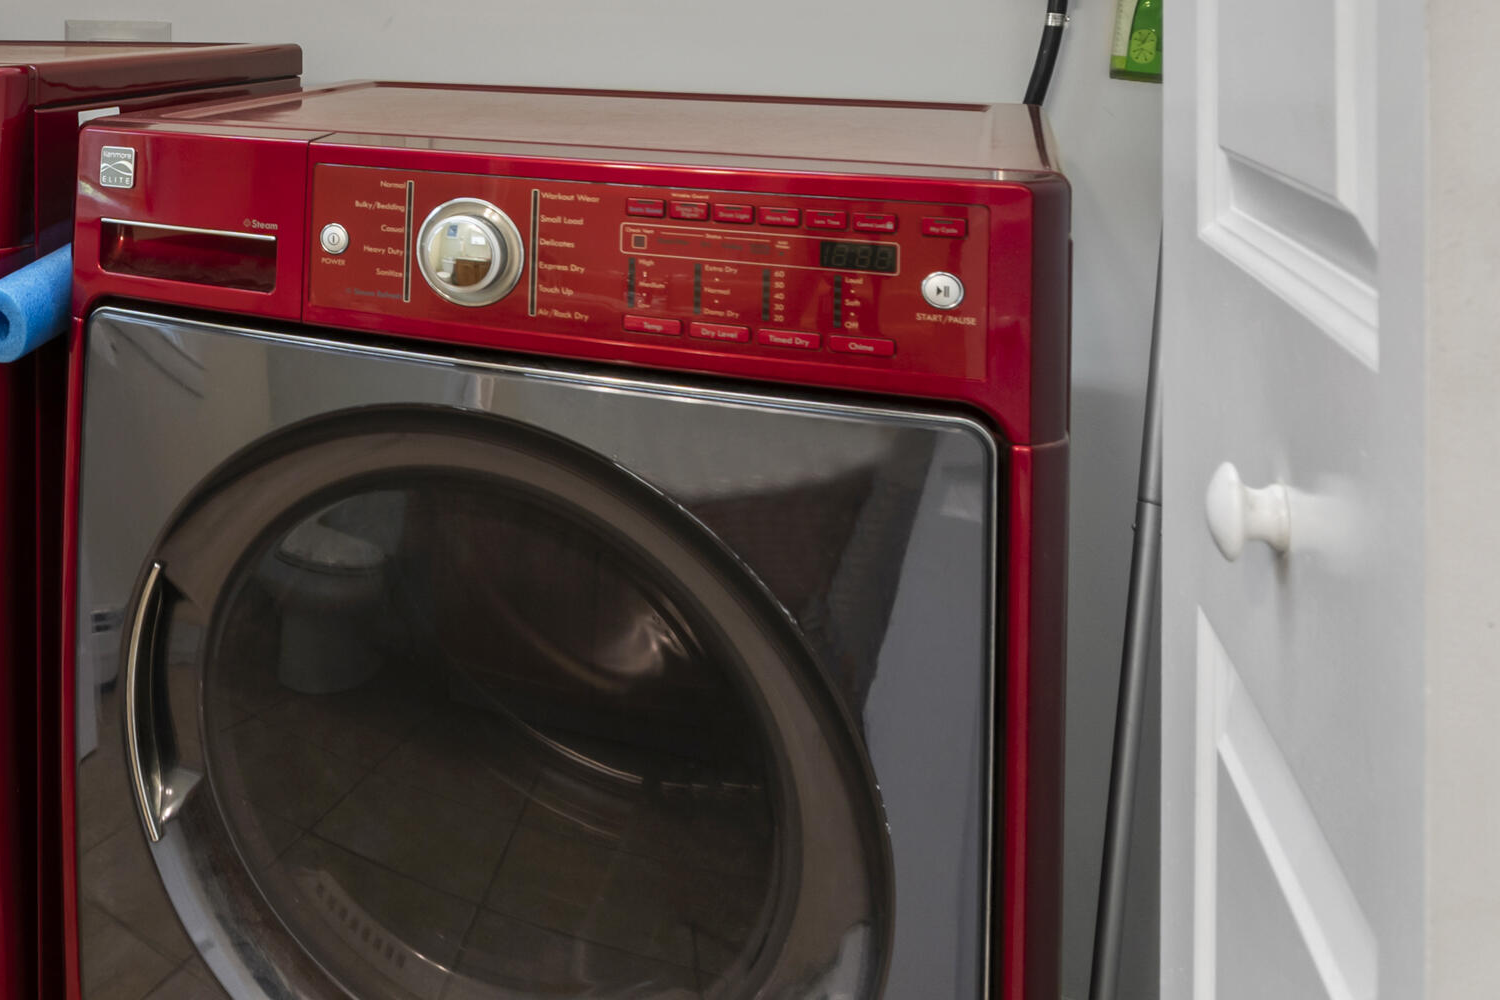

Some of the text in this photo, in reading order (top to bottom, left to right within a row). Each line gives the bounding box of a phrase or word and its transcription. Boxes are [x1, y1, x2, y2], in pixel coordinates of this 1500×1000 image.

[103, 149, 132, 160] Kenmore
[102, 175, 131, 185] ELITE
[380, 180, 406, 189] Normal
[541, 191, 600, 203] Workout Wear
[355, 200, 405, 213] Bulky/Bedding
[540, 214, 584, 225] Small Load
[252, 219, 278, 231] Steam
[381, 224, 405, 233] Casual
[540, 238, 575, 248] Delicates
[363, 245, 404, 256] Heavy Duty
[321, 257, 346, 266] POWER
[638, 258, 654, 267] High
[539, 261, 585, 274] Express Dry
[704, 264, 738, 274] Extra Dry
[376, 268, 403, 278] Sanitize
[774, 270, 785, 278] 60
[774, 281, 785, 289] 50
[844, 277, 864, 285] Loud
[539, 284, 574, 297] Touch Up
[704, 287, 731, 295] Normal
[773, 292, 785, 300] 40
[773, 303, 785, 311] 30
[844, 299, 861, 307] Soft
[538, 308, 589, 322] Air/Rack Dry
[726, 310, 739, 319] Dry
[773, 314, 785, 322] 20
[916, 312, 977, 326] START/PAUSE
[643, 321, 664, 332] Temp
[844, 321, 859, 329] Off
[700, 328, 738, 339] Dry Level
[768, 334, 810, 348] Timed Dry
[848, 341, 875, 352] Chime
